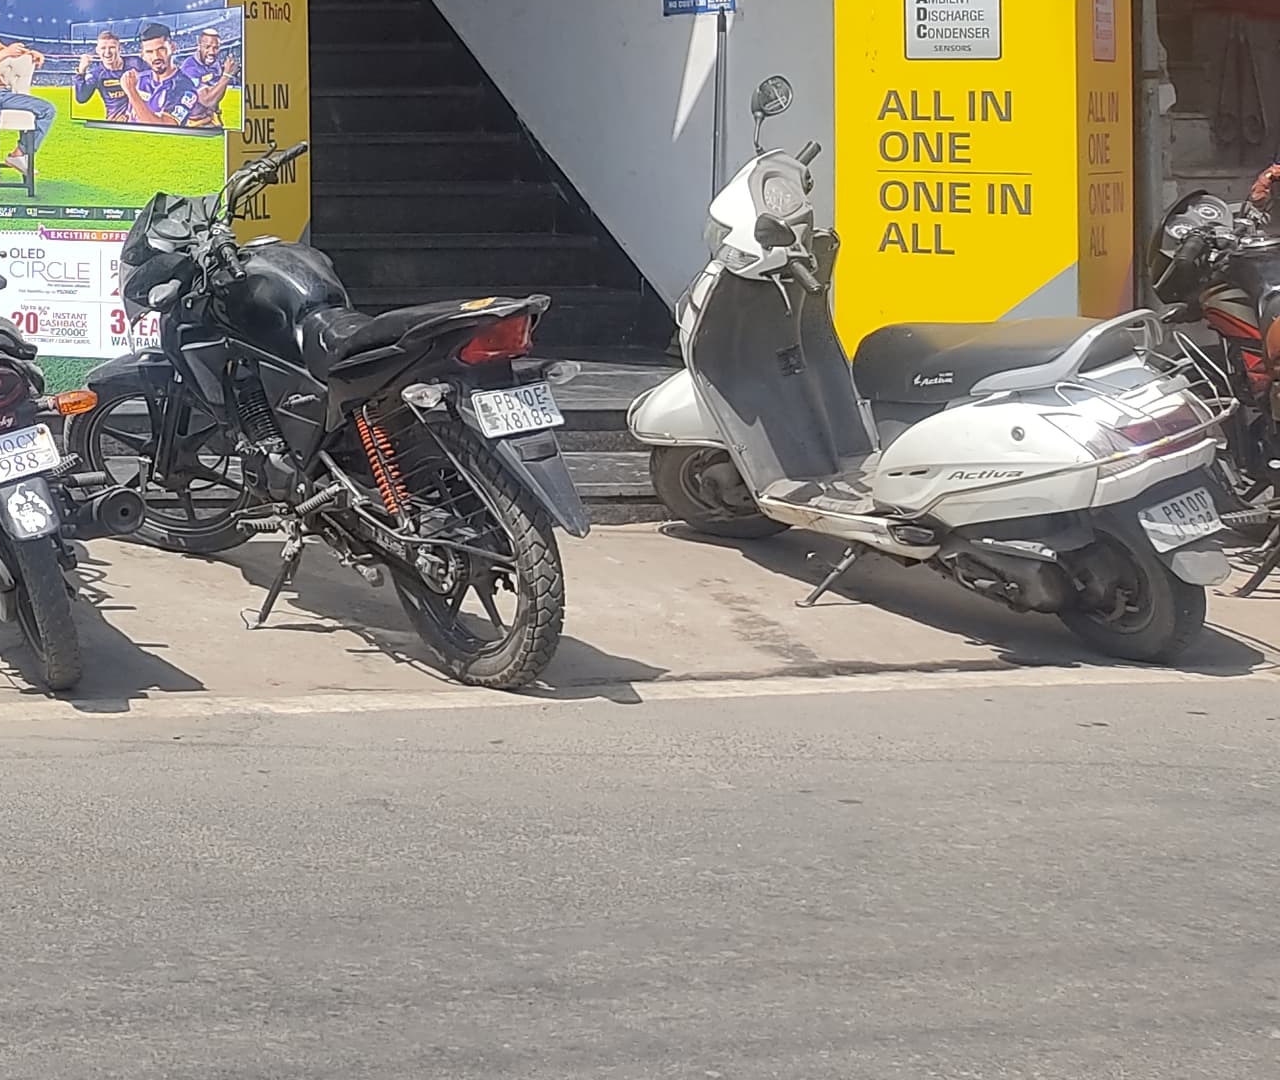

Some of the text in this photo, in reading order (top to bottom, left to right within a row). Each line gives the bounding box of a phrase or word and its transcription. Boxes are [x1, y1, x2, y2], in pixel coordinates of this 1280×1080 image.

[915, 6, 985, 22] DISCHARGE
[915, 23, 991, 40] CONDENSER
[933, 44, 973, 53] SENSORS
[876, 90, 1013, 123] ALL IN
[1087, 91, 1120, 124] ALL IN
[878, 131, 972, 164] ONE
[1087, 133, 1111, 166] ONE
[878, 180, 1032, 216] ONE IN
[1087, 182, 1125, 217] ONE IN
[876, 223, 956, 256] ALL
[1088, 225, 1108, 257] ALL
[9, 247, 46, 259] OLED
[9, 260, 91, 281] CIRCLE
[39, 319, 88, 328] CASHBACK
[52, 312, 88, 321] INSTANT
[494, 387, 544, 413] PB10E
[946, 468, 1025, 482] Activa
